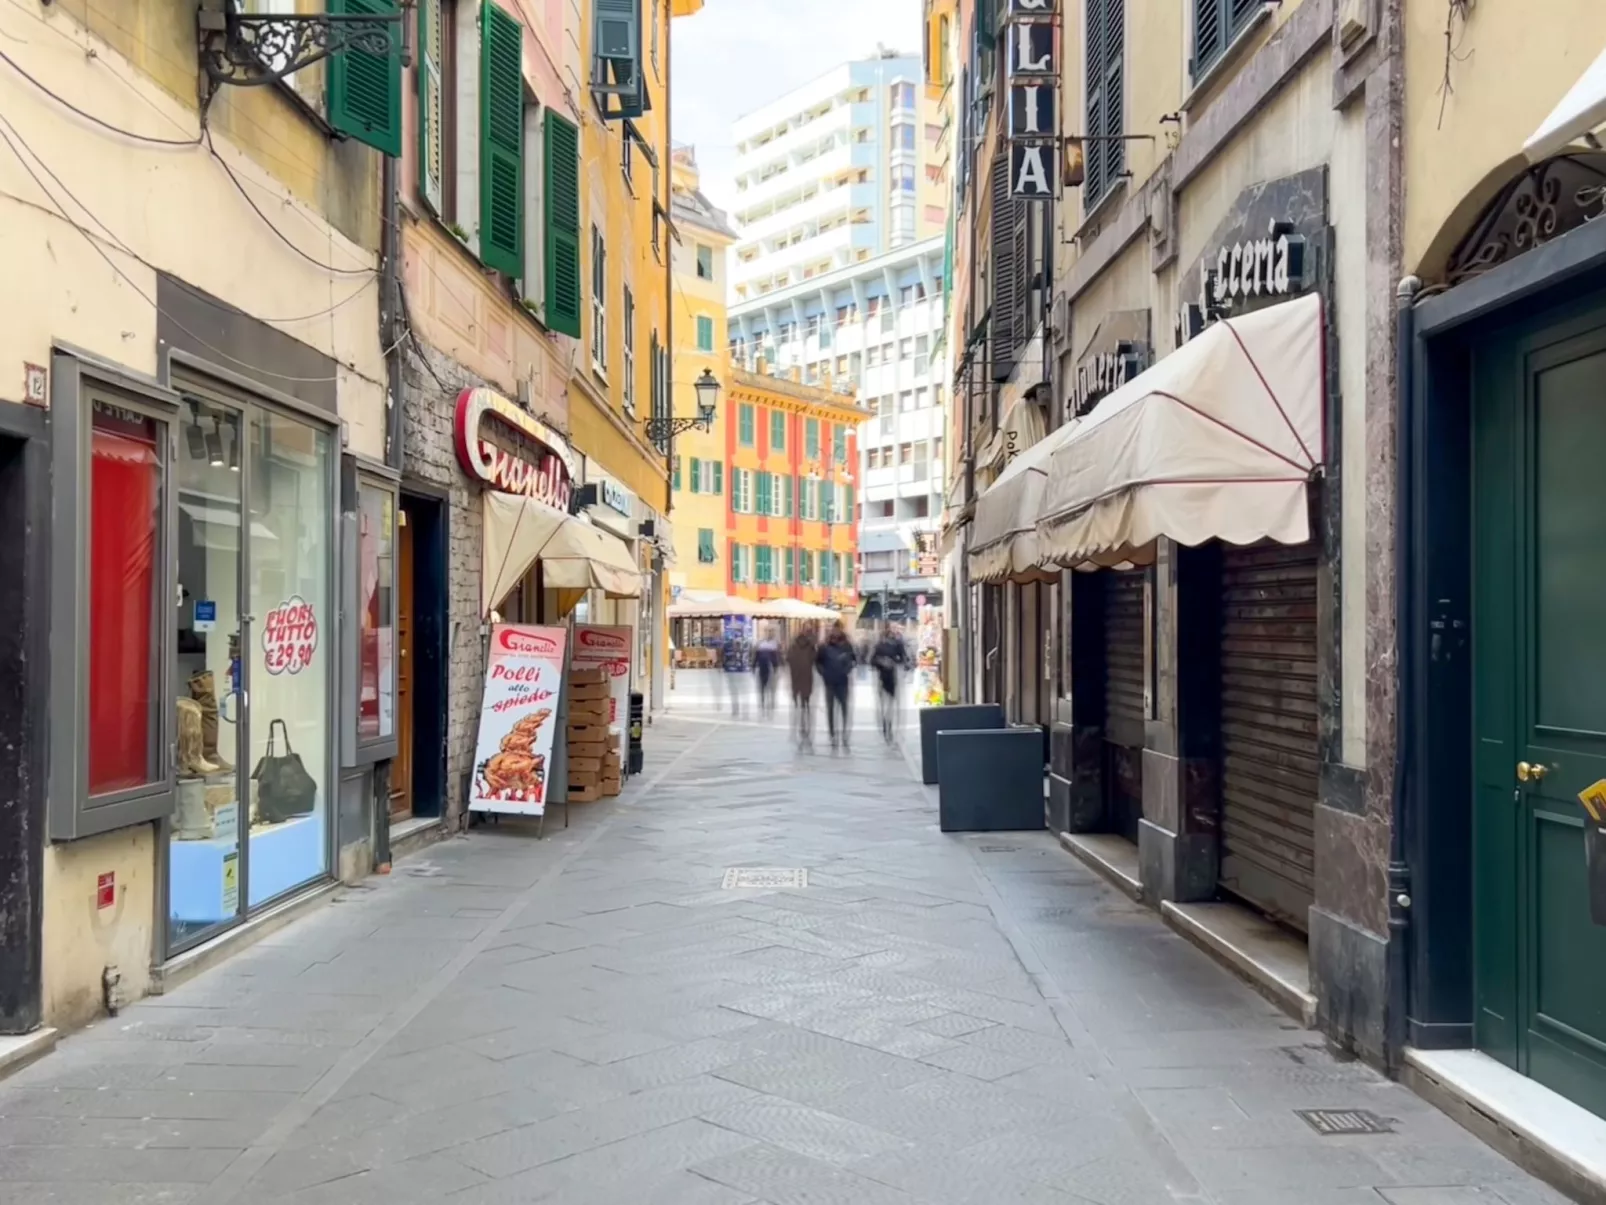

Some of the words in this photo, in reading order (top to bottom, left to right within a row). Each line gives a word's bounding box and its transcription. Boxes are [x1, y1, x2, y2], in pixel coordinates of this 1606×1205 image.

[33, 376, 42, 395] 12
[266, 603, 313, 627] FUORI
[267, 621, 315, 643] TUTTO
[491, 664, 541, 682] Polli
[508, 684, 530, 693] allo
[493, 688, 550, 712] spiedo
